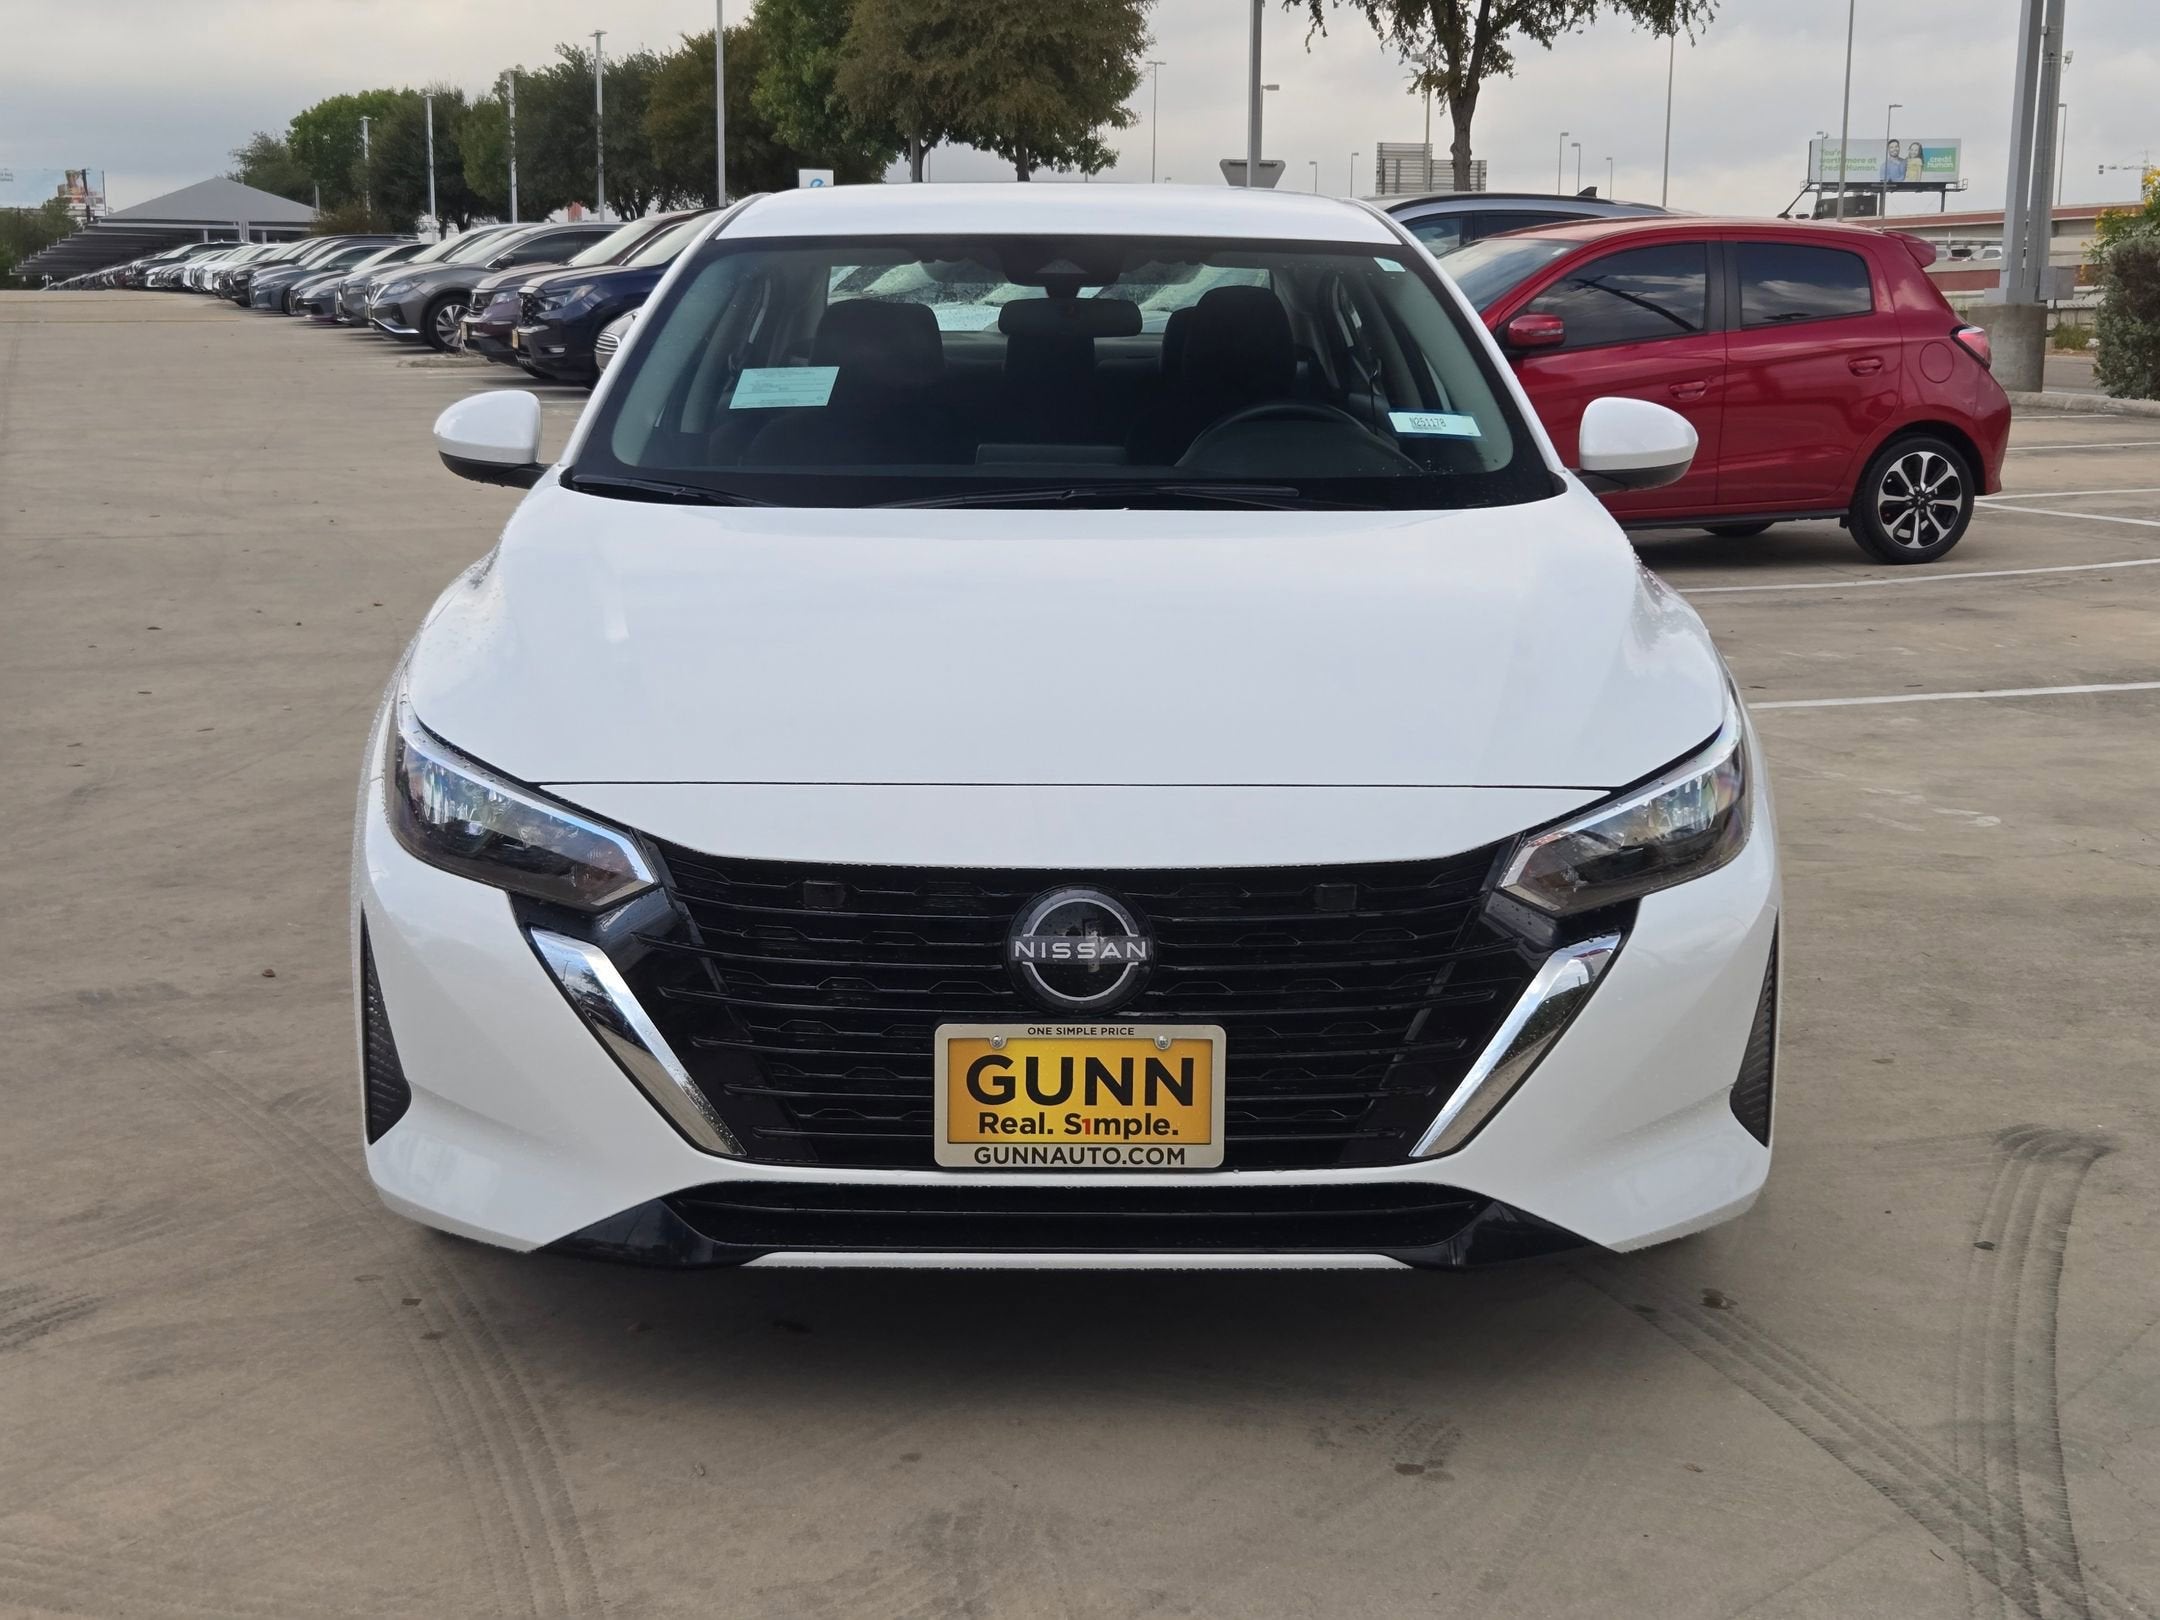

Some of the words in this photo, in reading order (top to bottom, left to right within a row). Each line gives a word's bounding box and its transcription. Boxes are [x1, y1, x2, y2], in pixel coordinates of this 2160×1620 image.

[1015, 941, 1146, 959] NISSAN
[1027, 1026, 1052, 1036] ONE
[1055, 1026, 1097, 1036] SIMPLE
[1101, 1027, 1135, 1036] PRICE
[966, 1054, 1194, 1106] GUNN
[978, 1112, 1053, 1135] Real.
[974, 1146, 1185, 1165] GUNNAUTO.COM
